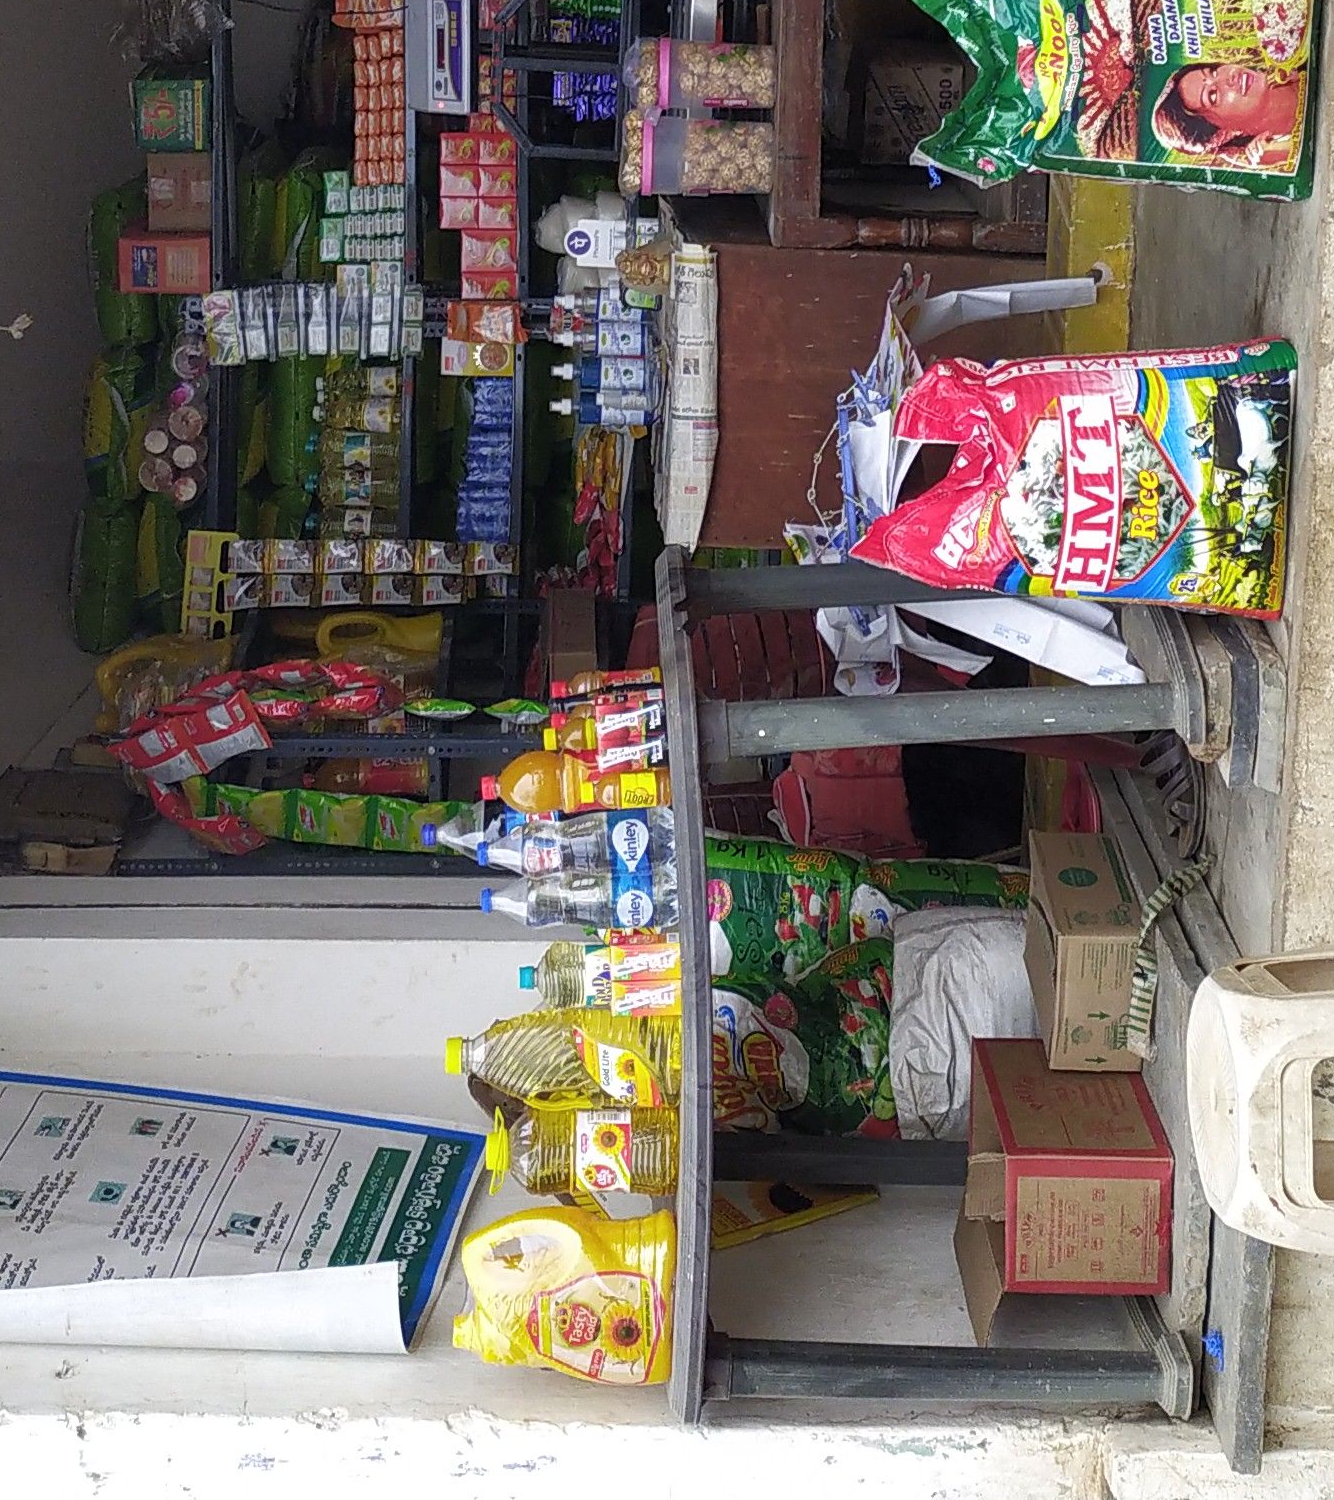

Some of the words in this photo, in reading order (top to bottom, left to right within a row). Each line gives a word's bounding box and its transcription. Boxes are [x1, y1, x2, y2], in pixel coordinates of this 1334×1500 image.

[1066, 13, 1078, 36] Rice
[1149, 14, 1166, 63] DAANA
[1183, 14, 1200, 56] KHILA
[940, 79, 952, 109] 500
[1061, 407, 1114, 586] HMT
[1129, 471, 1159, 540] Rice
[623, 821, 638, 861] kinley
[569, 1307, 588, 1343] Tasty
[584, 1316, 598, 1340] Gold
